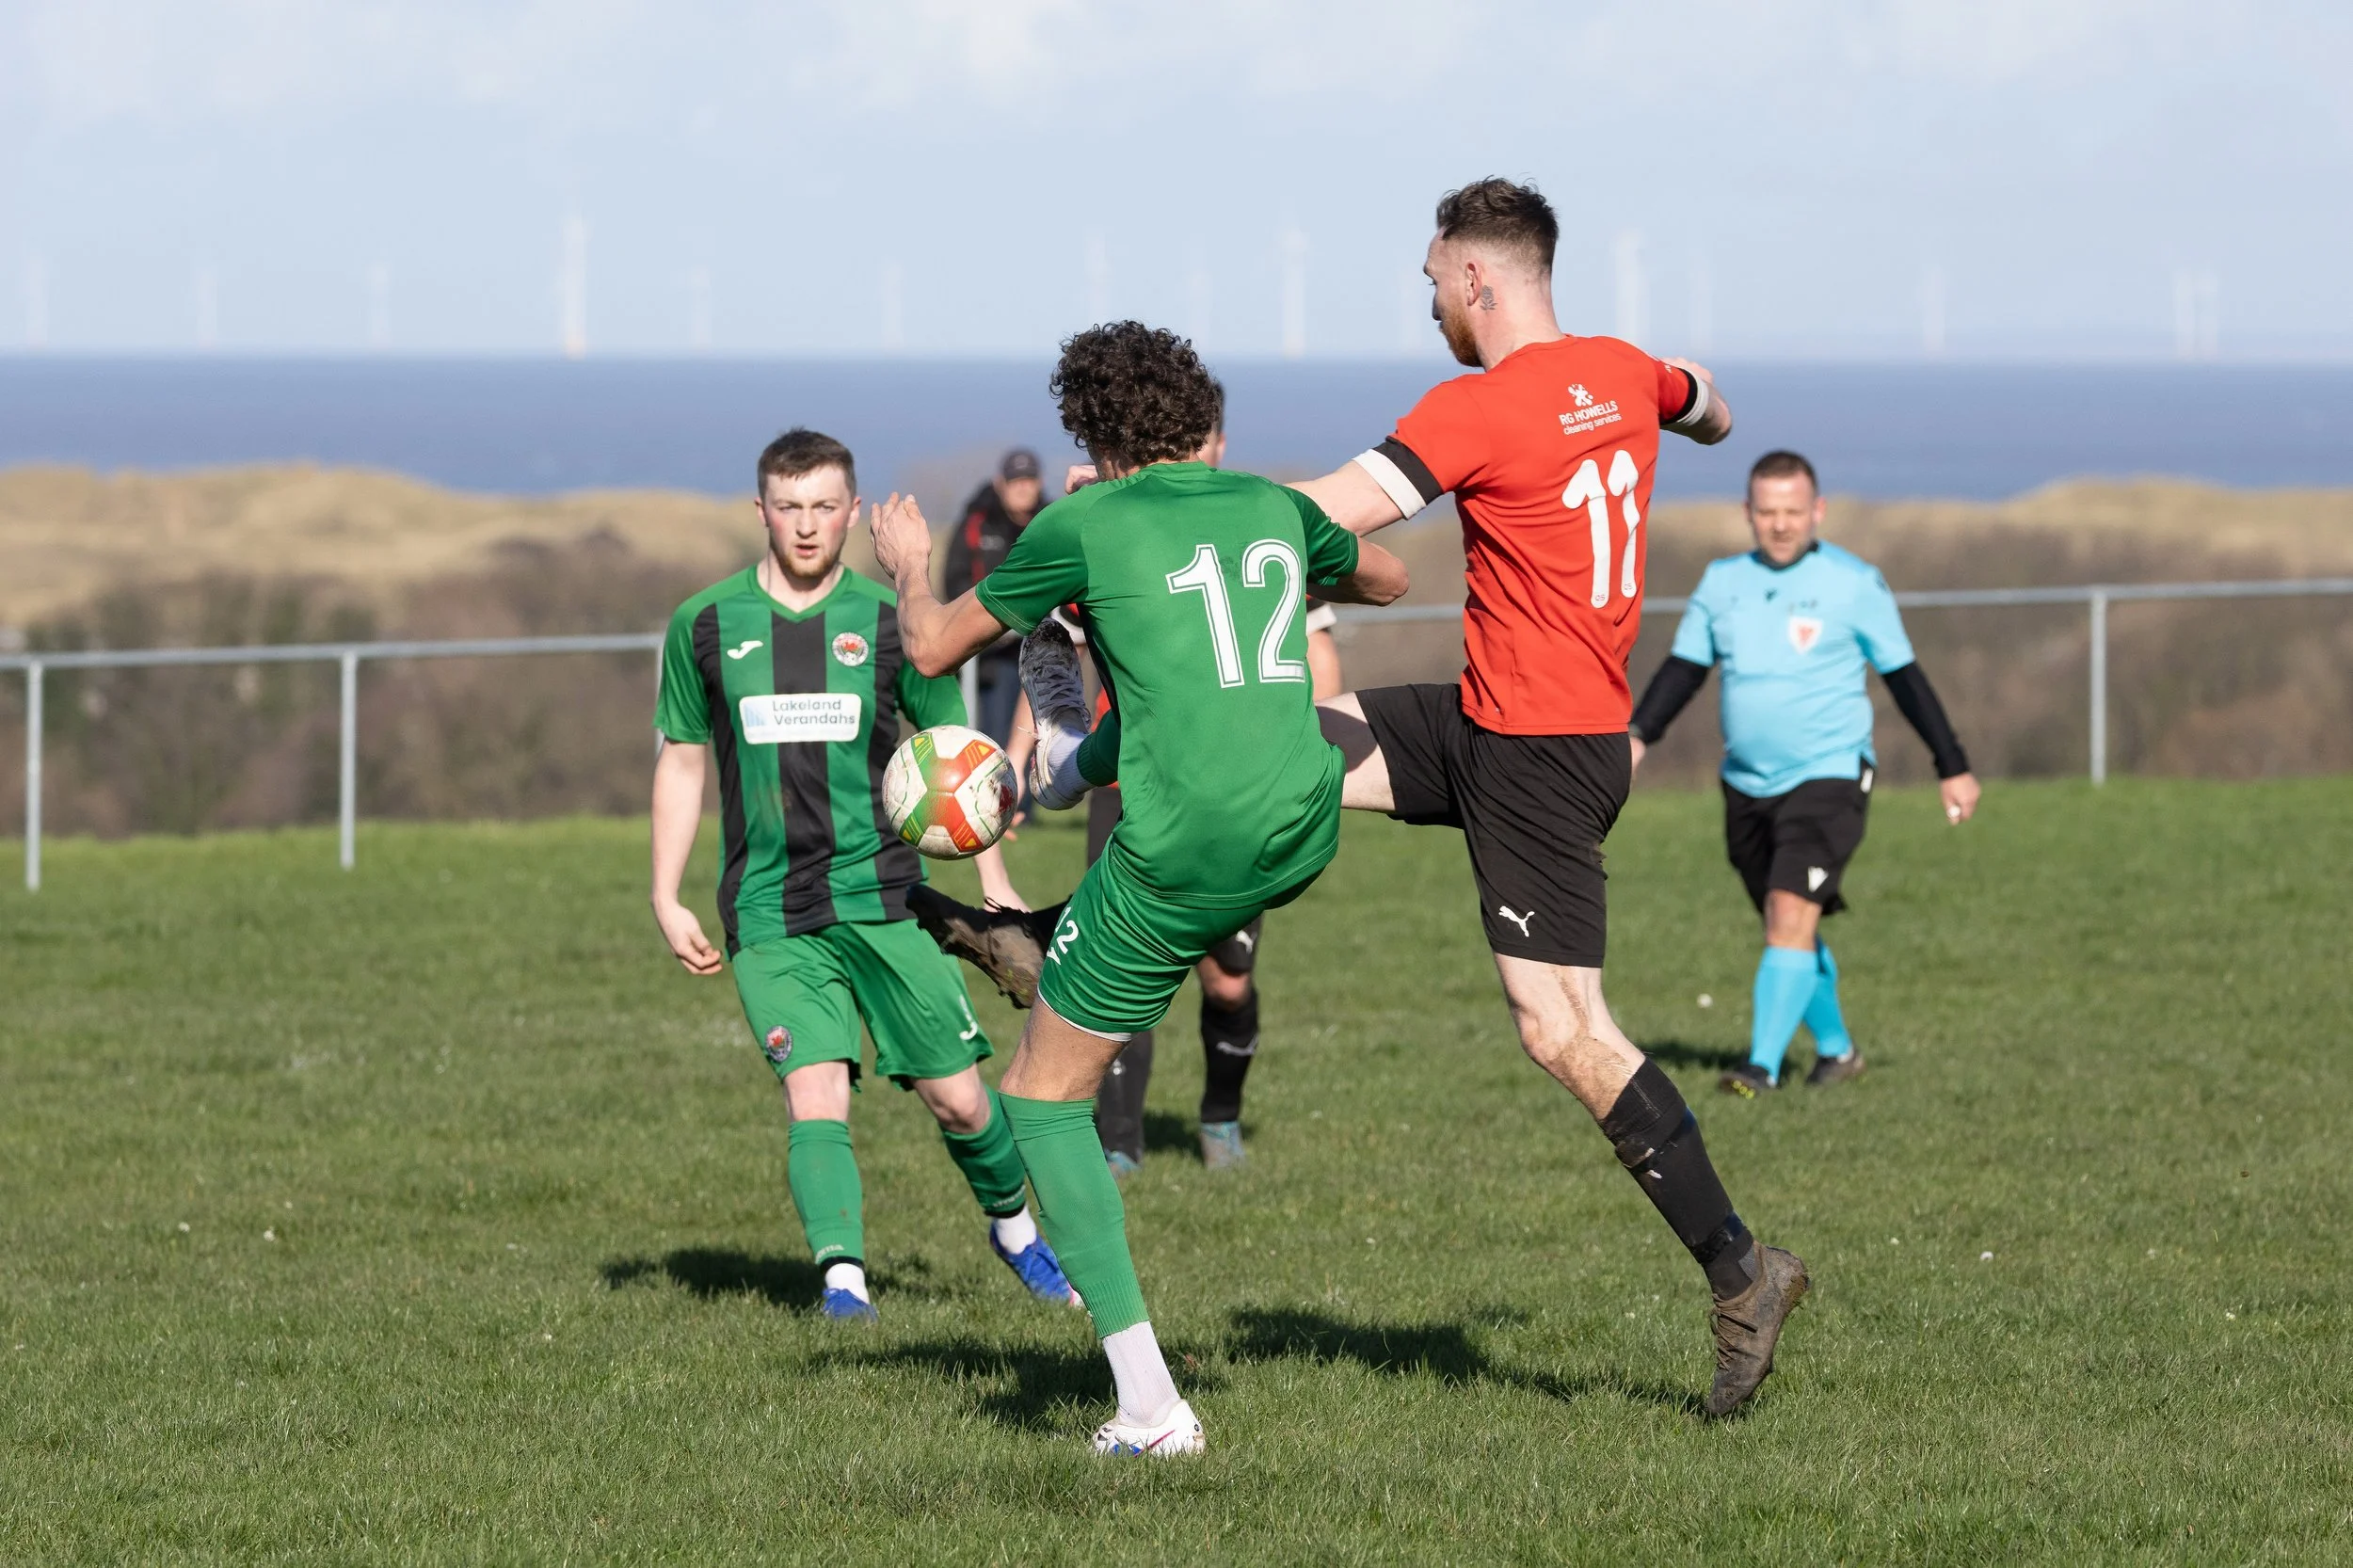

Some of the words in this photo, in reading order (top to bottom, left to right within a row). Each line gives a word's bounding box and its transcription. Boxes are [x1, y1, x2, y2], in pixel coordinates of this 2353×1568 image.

[1559, 412, 1576, 425] RG
[1574, 400, 1619, 422] HOWELLS
[1563, 421, 1595, 435] cleaning
[1593, 412, 1623, 426] services
[1561, 450, 1641, 609] 11
[1165, 538, 1305, 688] 12
[772, 699, 841, 712] Lakeland
[774, 712, 856, 726] Verandahs
